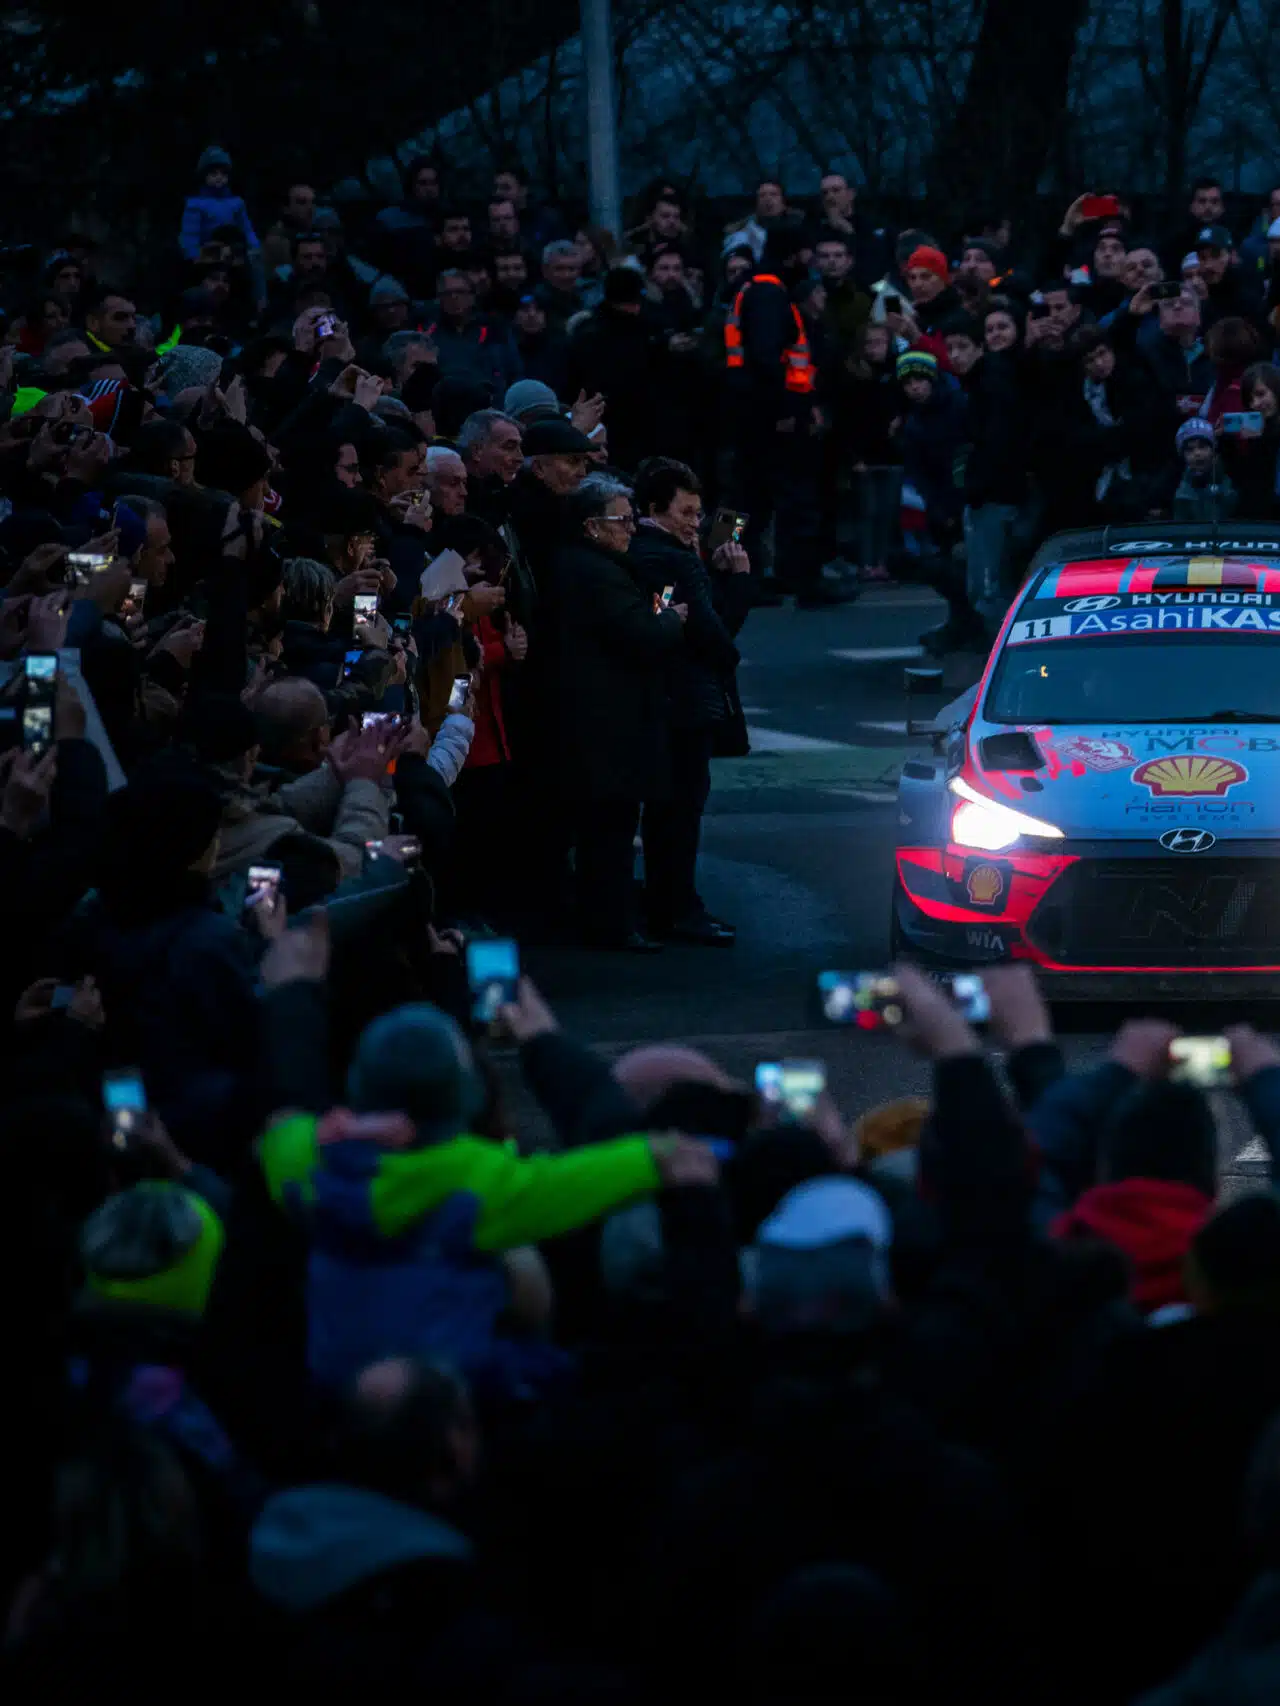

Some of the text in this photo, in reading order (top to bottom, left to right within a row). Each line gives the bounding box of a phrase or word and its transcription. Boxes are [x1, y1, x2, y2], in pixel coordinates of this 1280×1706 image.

[1131, 592, 1271, 606] HYUNDAI
[1024, 620, 1052, 640] 11
[1101, 728, 1239, 738] HYUNDAI
[1125, 801, 1255, 815] Hanon
[967, 930, 1005, 952] WIA
